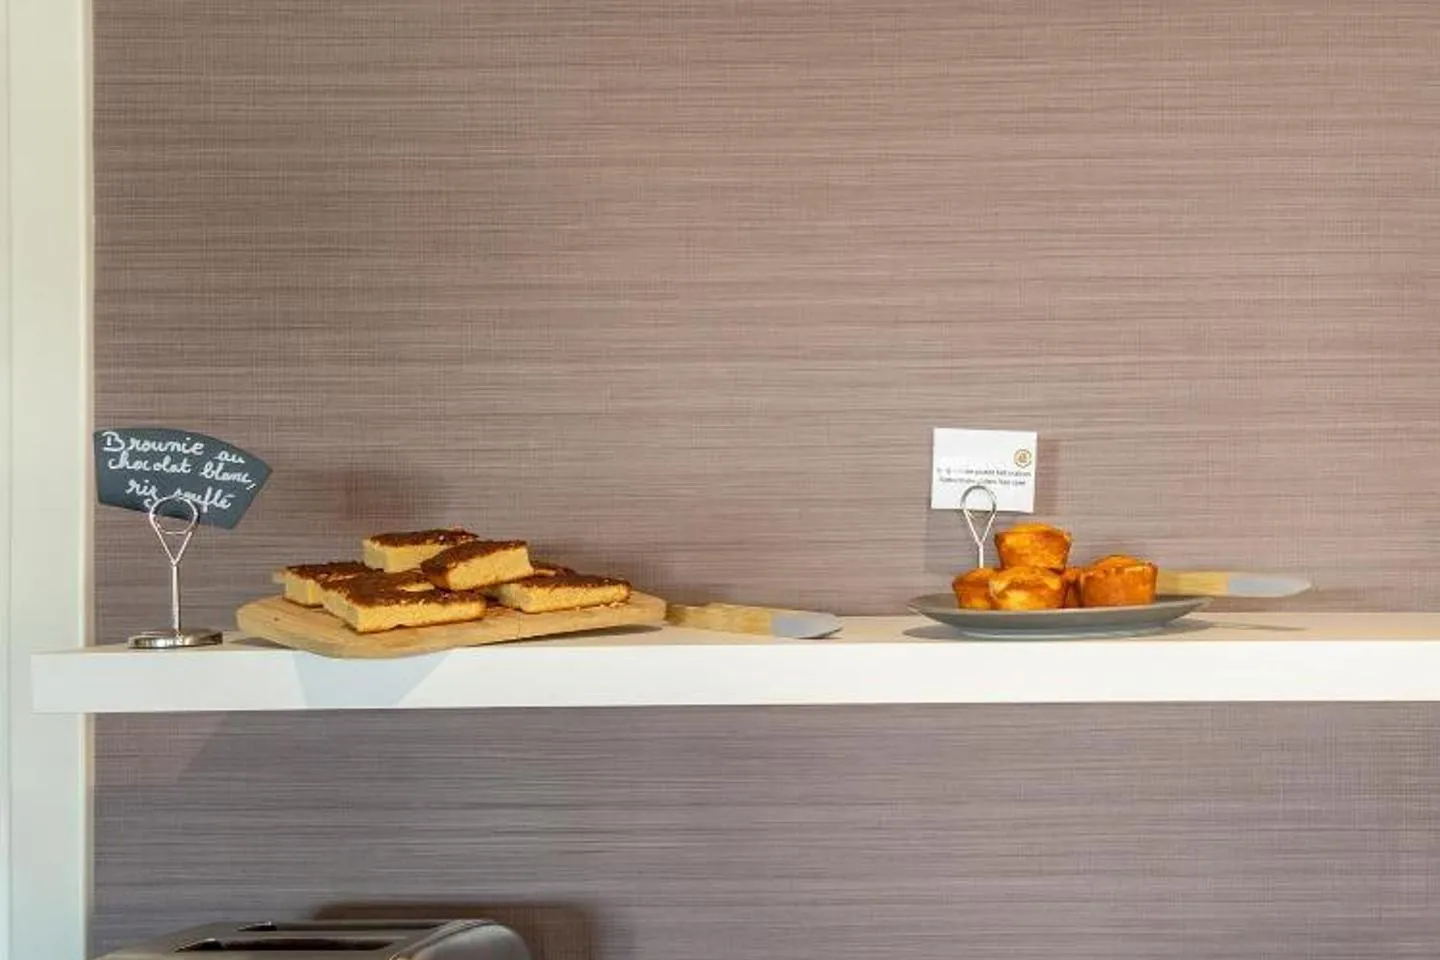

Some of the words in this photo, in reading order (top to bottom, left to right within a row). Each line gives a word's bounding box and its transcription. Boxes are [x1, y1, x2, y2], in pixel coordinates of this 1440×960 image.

[101, 431, 204, 456] Brownie
[214, 450, 246, 464] au
[108, 451, 191, 474] chocolat
